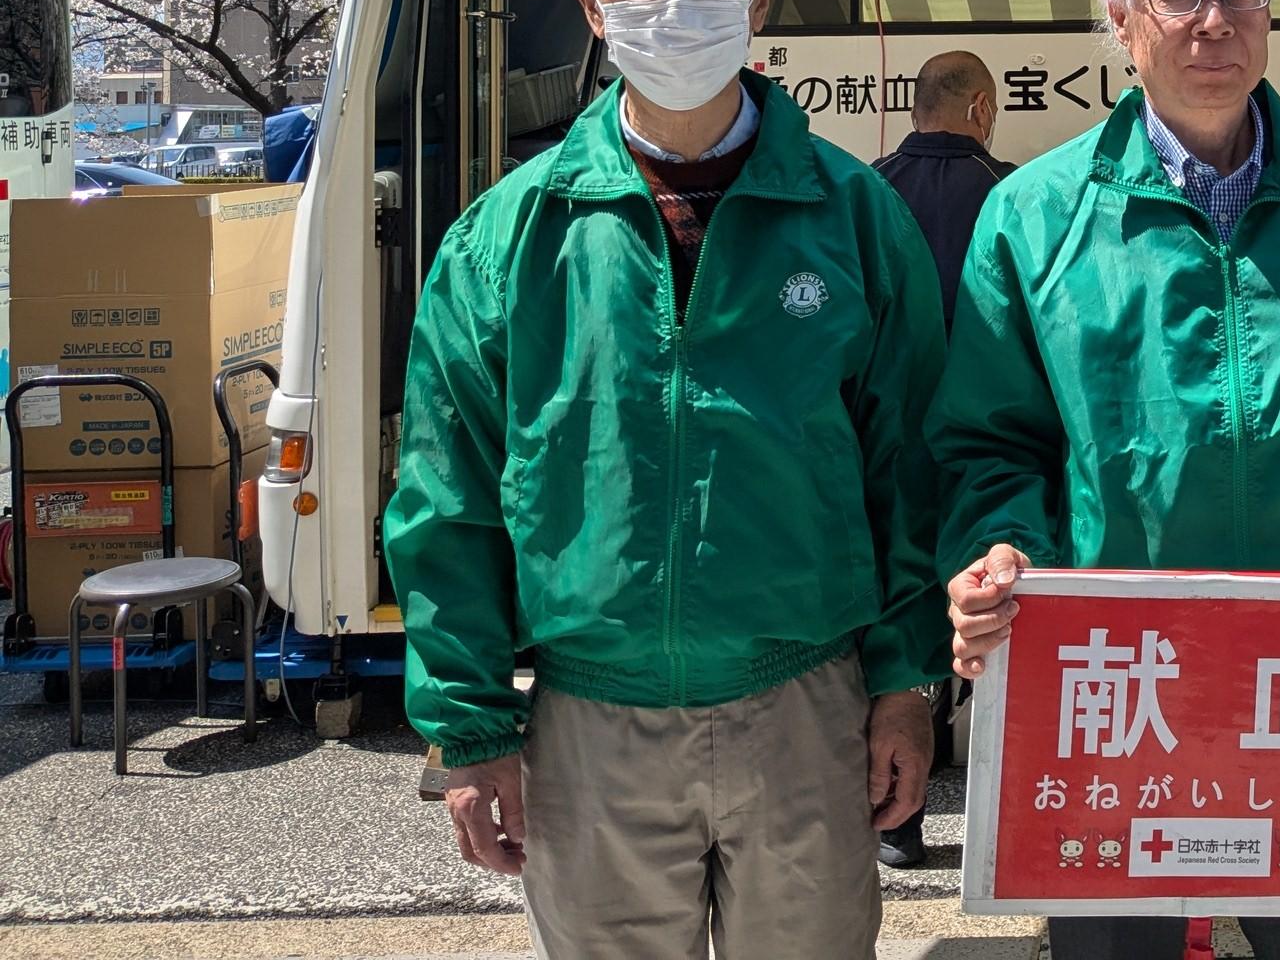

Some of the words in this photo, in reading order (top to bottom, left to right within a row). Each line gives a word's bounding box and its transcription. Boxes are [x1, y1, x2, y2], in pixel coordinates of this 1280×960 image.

[768, 46, 788, 67] 都
[769, 74, 917, 115] の献血
[791, 274, 820, 285] LIONS
[798, 286, 810, 302] L
[63, 342, 110, 355] SIMPLE
[112, 341, 143, 354] ECO
[153, 343, 170, 357] 5P
[223, 328, 261, 357] SIMPLE
[126, 366, 166, 374] TISSUES
[231, 372, 251, 387] 2-PLY
[128, 541, 162, 549] TISSUE
[1178, 839, 1261, 854] 日本赤十字社
[1177, 857, 1206, 865] Japanese
[1238, 857, 1261, 865] Society
